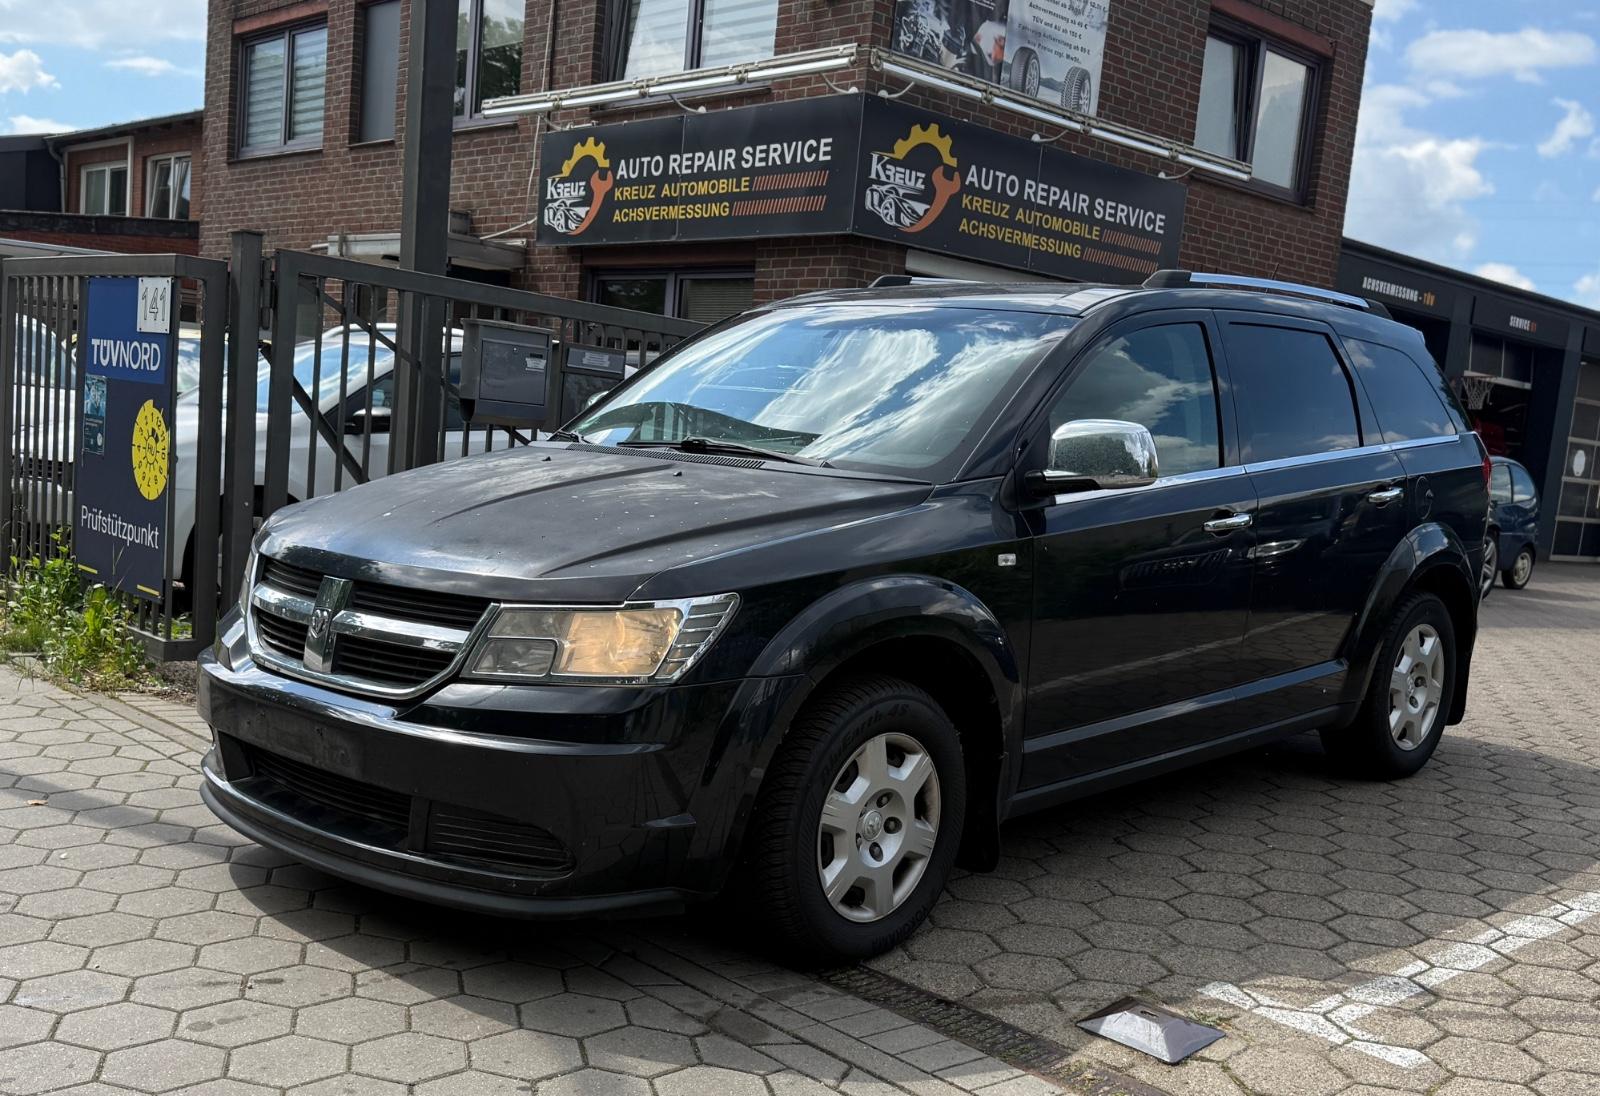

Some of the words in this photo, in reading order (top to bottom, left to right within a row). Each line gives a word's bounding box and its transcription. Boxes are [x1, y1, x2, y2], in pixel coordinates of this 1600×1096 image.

[616, 155, 664, 180] AUTO
[668, 148, 736, 174] REPAIR
[741, 138, 833, 168] SERVICE
[613, 184, 656, 201] KREUZ
[661, 176, 750, 198] AUTOMOBILE
[965, 165, 1019, 197] AUTO
[1024, 180, 1089, 216] REPAIR
[1093, 198, 1166, 235] SERVICE
[613, 202, 730, 223] ACHSVERMESSUNG
[962, 194, 1009, 219] KREUZ
[1015, 208, 1100, 241] AUTOMOBILE
[959, 217, 1082, 259] ACHSVERMESSUNG
[142, 287, 166, 321] 141
[1362, 276, 1418, 302] ACHSVERMESSUNG
[81, 505, 159, 550] Prüfstützpunkt
